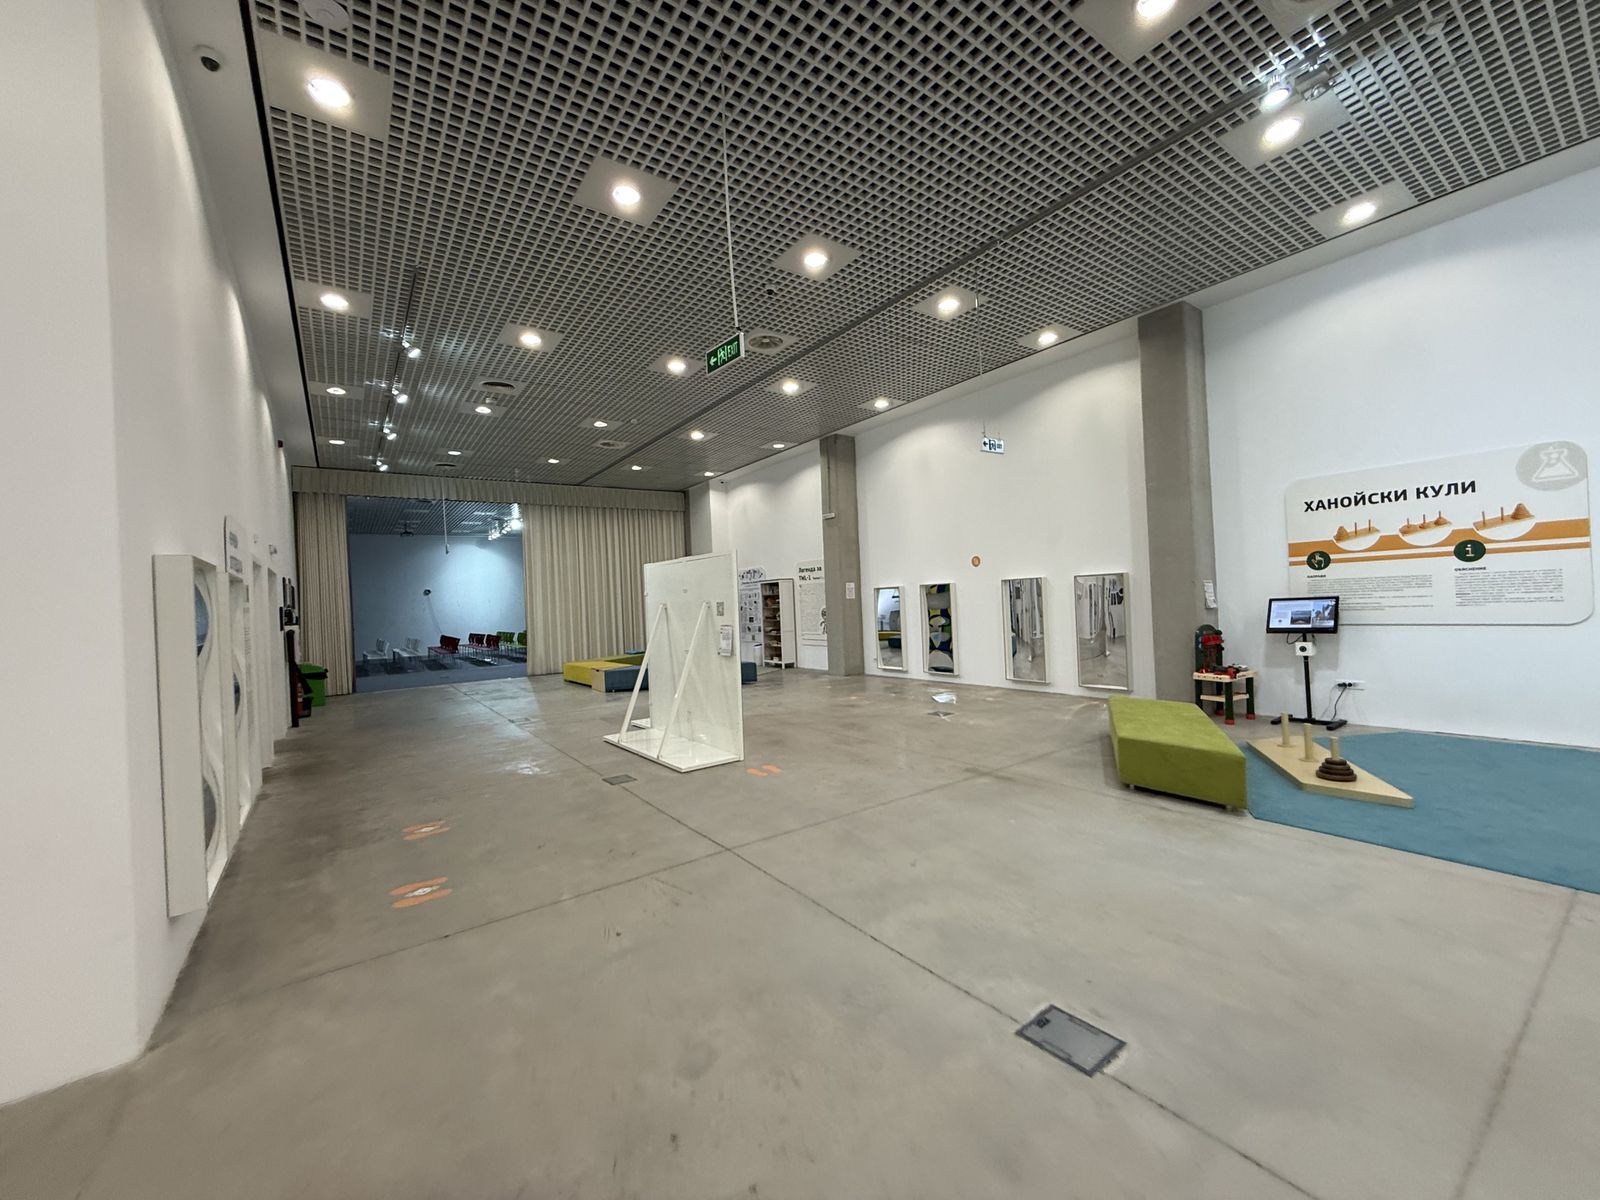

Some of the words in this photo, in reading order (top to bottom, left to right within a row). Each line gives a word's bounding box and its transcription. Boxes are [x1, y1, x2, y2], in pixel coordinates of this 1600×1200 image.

[727, 341, 738, 358] EXIT
[1304, 489, 1408, 512] ХАНОЙСКИ
[1415, 480, 1477, 500] КУЛИ
